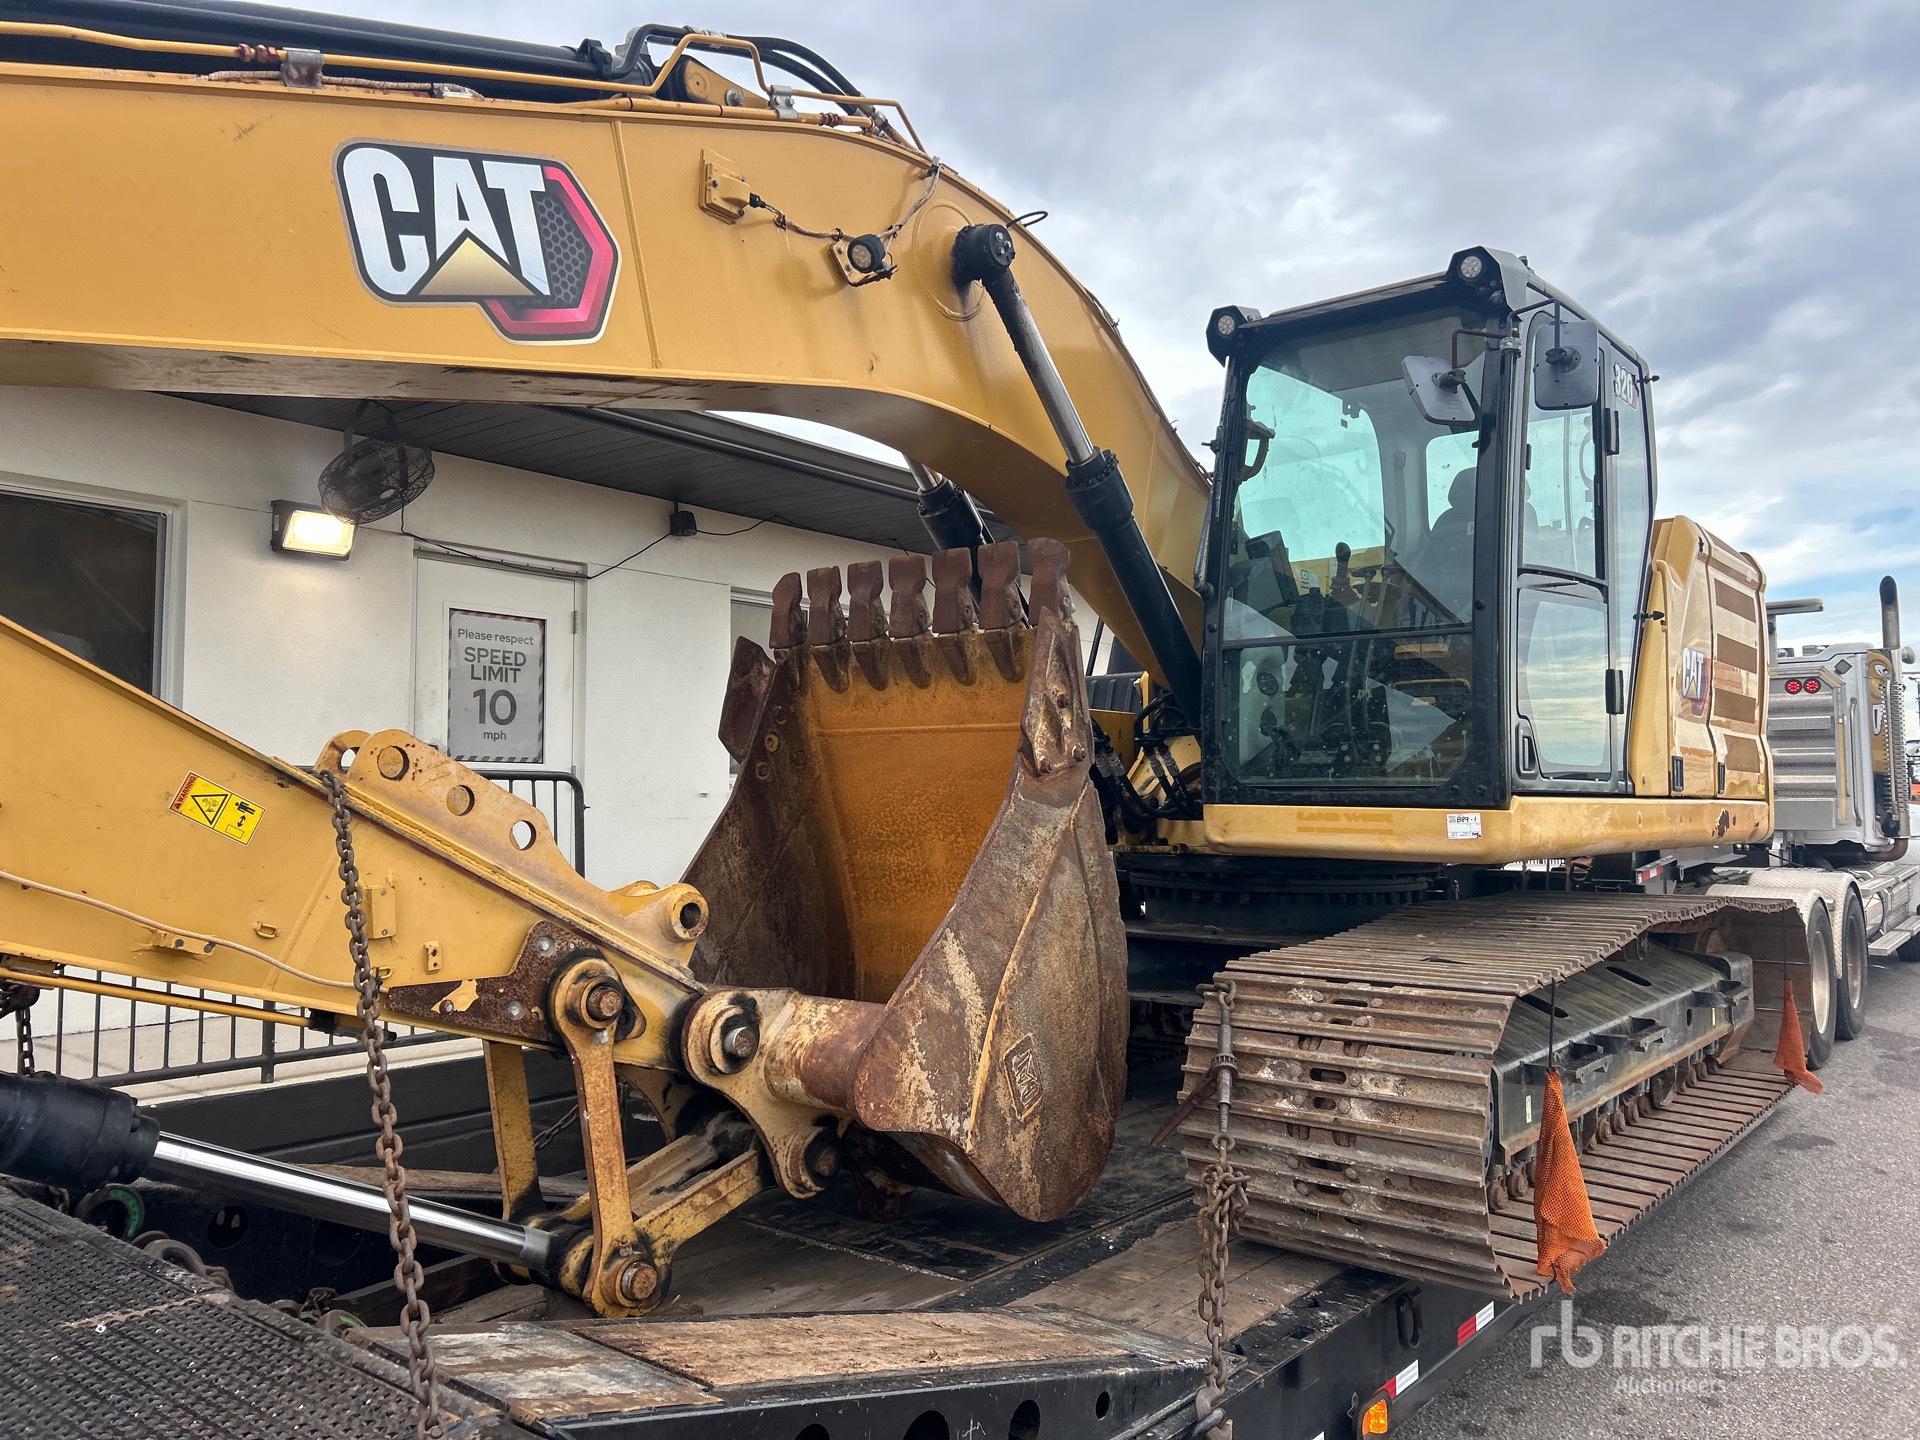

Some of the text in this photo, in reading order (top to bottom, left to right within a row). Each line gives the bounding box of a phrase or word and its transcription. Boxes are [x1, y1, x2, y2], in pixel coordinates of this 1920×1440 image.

[343, 147, 551, 296] CAT
[1615, 363, 1633, 405] 320
[457, 628, 534, 646] Please respect
[464, 646, 527, 667] SPEED
[470, 664, 521, 683] LIMIT
[1682, 647, 1704, 701] CAT
[472, 688, 517, 726] 10
[483, 730, 507, 742] mph
[179, 776, 196, 803] WARNING
